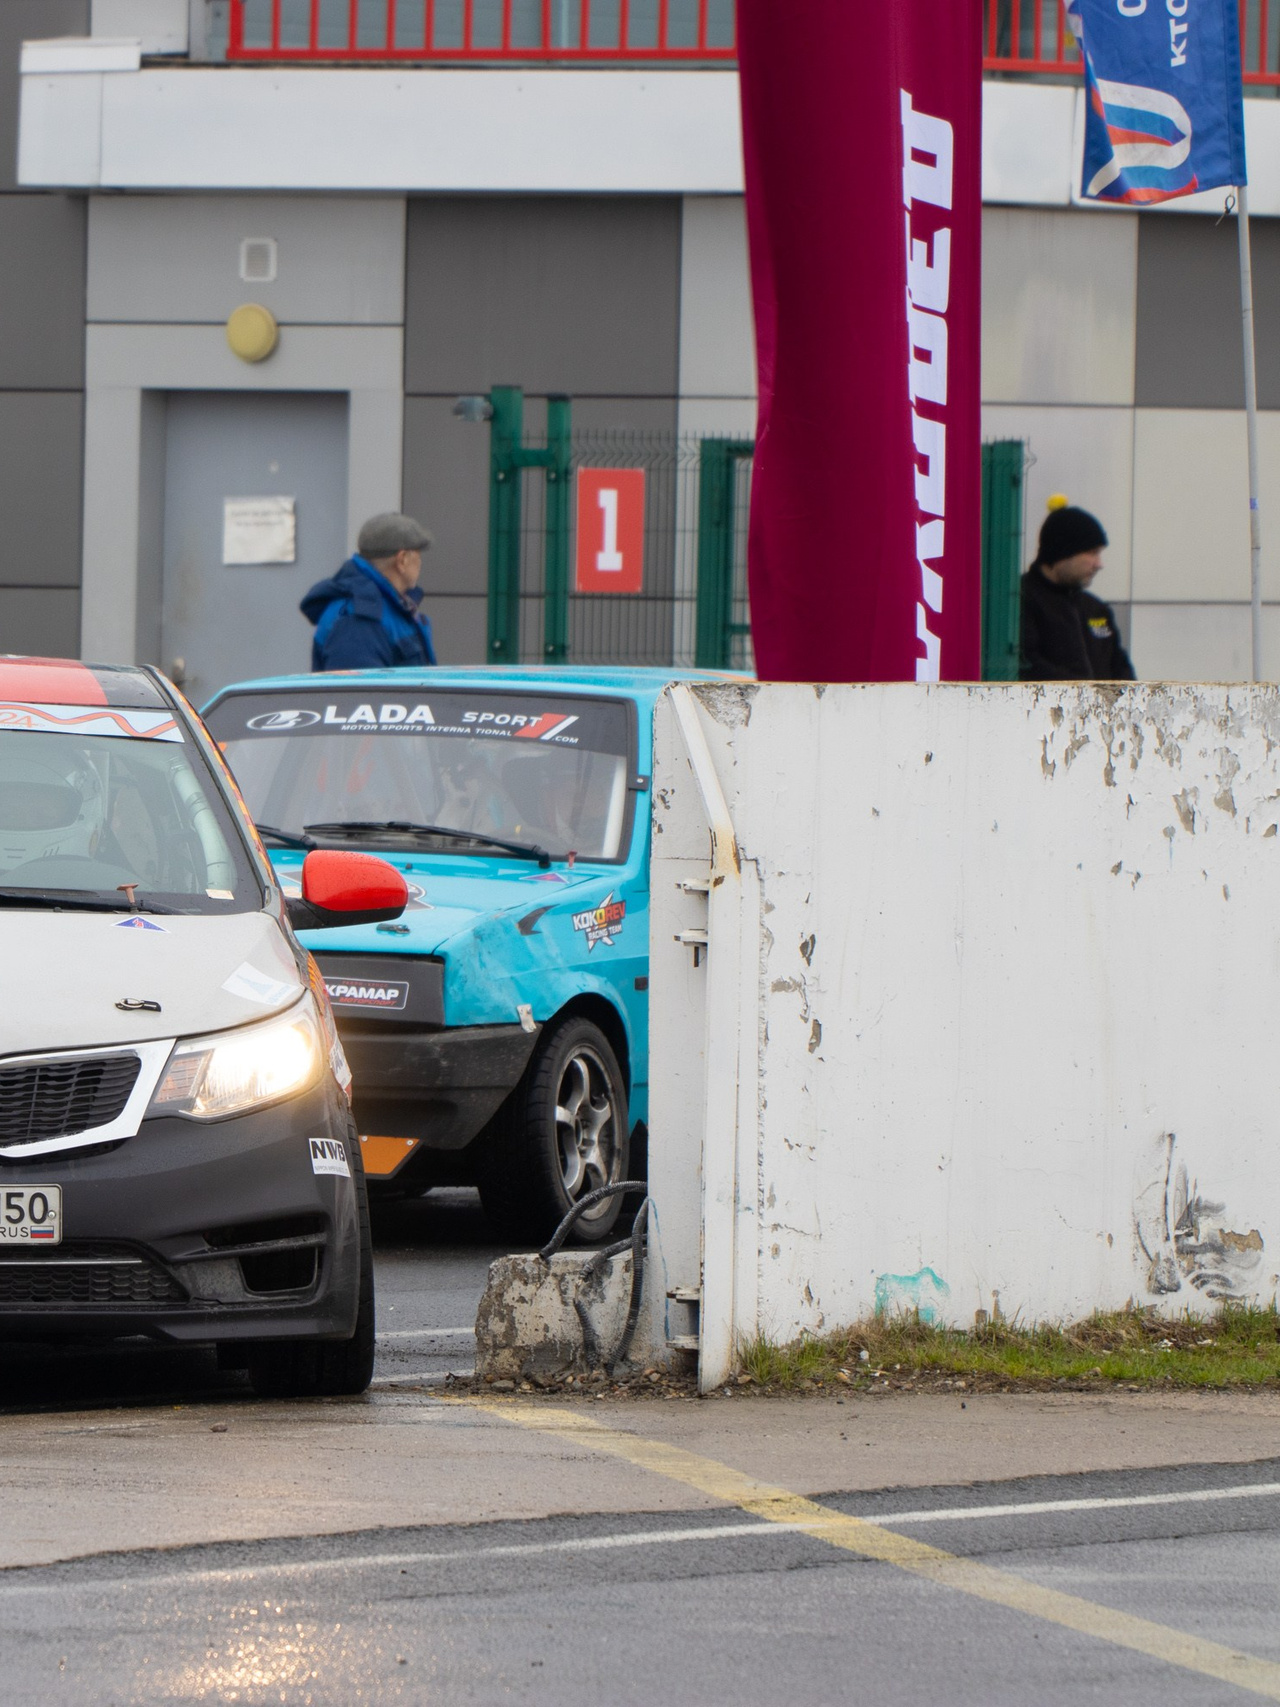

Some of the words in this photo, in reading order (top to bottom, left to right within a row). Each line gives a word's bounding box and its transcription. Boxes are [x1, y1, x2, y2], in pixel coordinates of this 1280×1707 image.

[596, 488, 623, 572] 1
[324, 704, 436, 725] LADA
[462, 711, 543, 727] SPORT
[572, 901, 626, 931] KOKOREV
